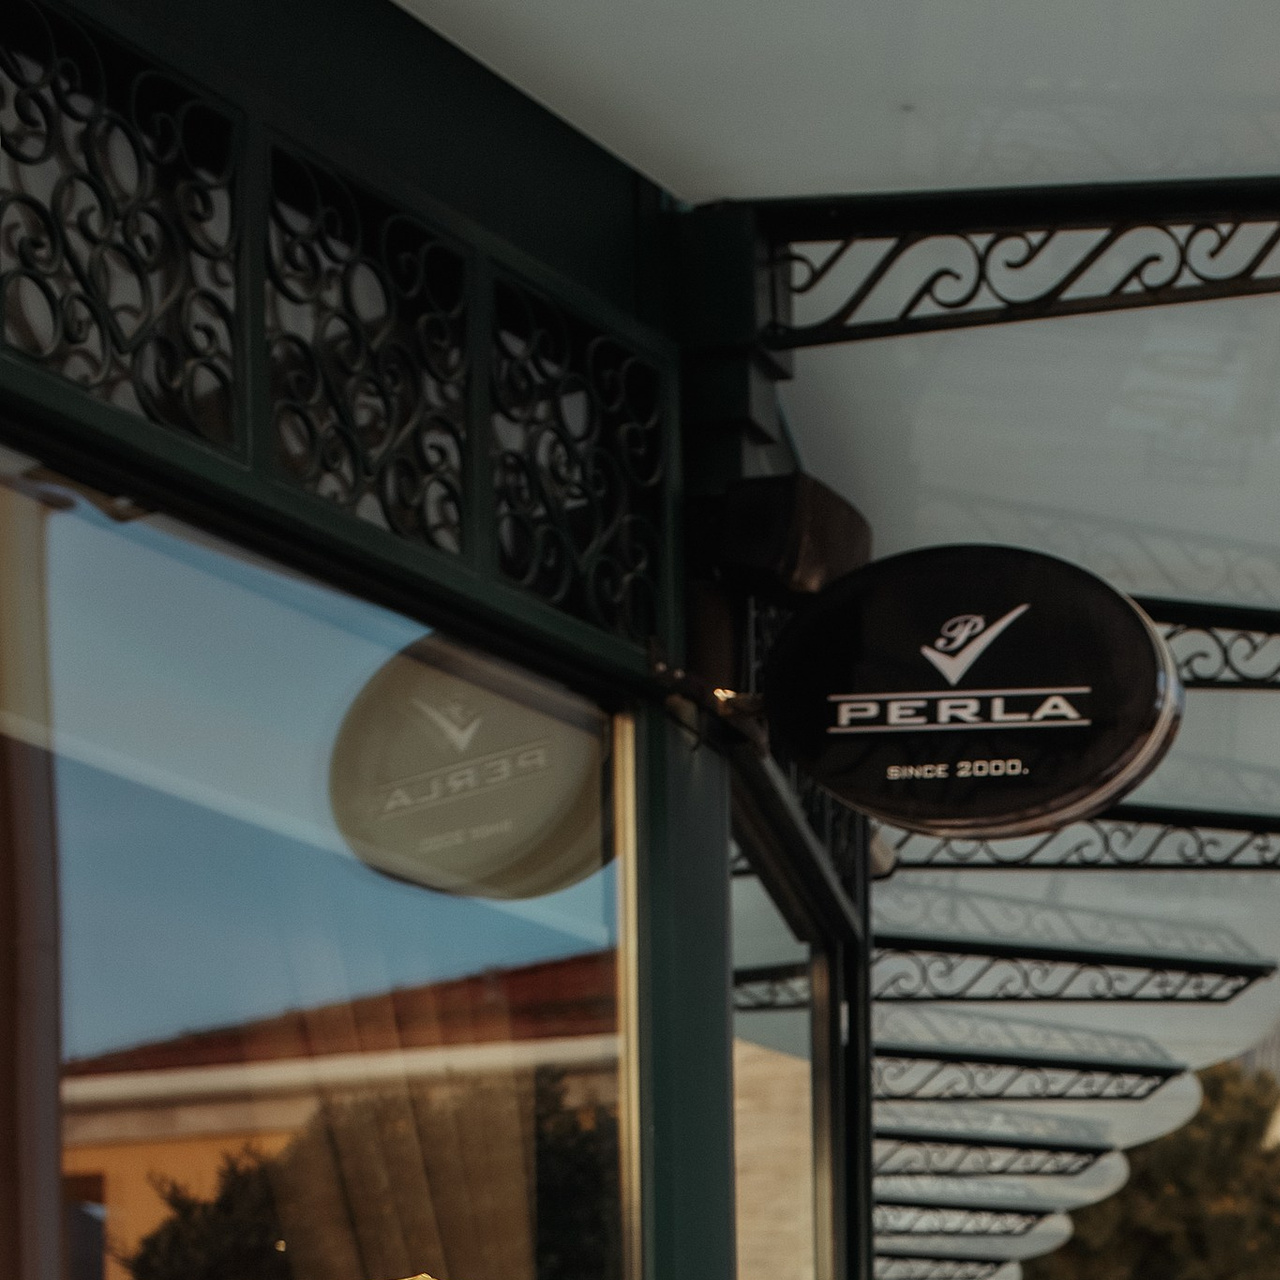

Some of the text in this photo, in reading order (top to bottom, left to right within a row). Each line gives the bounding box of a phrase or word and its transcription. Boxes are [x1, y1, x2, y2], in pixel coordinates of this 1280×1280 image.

[837, 695, 1082, 727] PERLA
[886, 758, 1030, 780] SINCE 2000.
